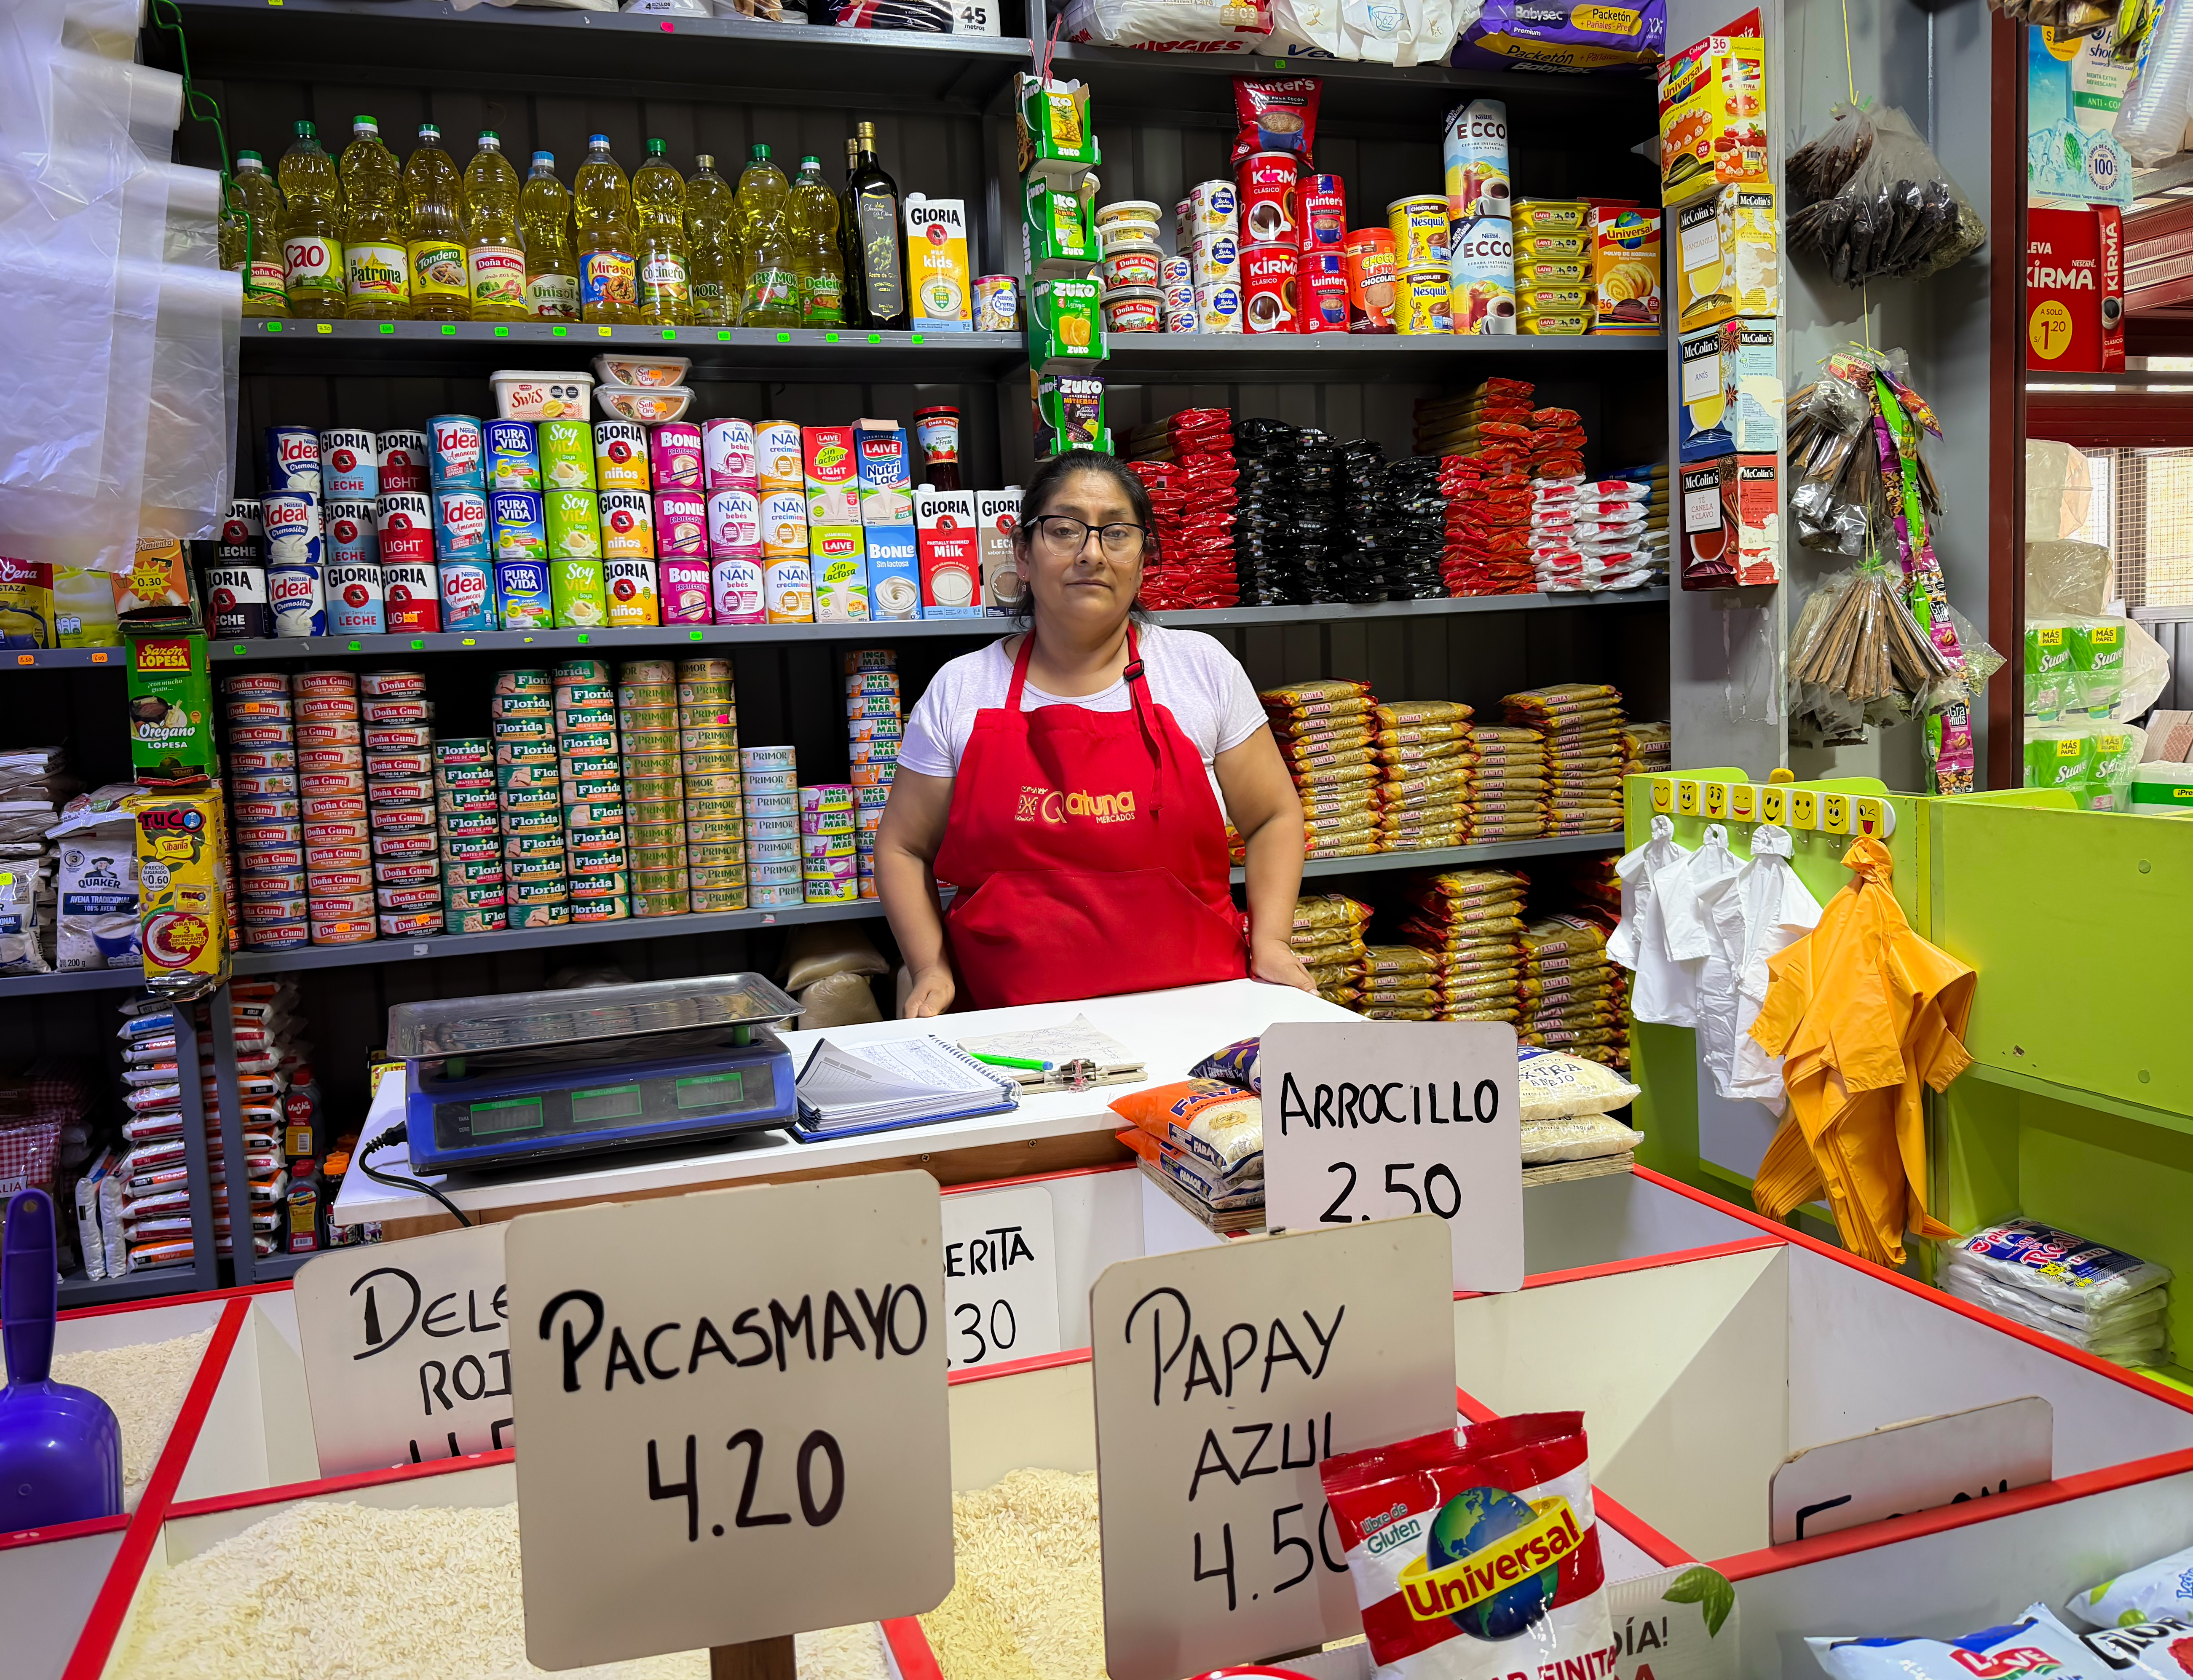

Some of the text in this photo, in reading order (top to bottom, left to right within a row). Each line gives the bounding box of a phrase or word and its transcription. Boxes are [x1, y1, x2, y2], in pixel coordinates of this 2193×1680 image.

[1516, 6, 1563, 21] Babysec
[1593, 8, 1631, 22] Packetón
[1713, 38, 1726, 49] 36
[2088, 98, 2102, 106] ANTI
[1457, 122, 1506, 139] ECCO
[1058, 147, 1080, 157] ZUKO
[2094, 158, 2113, 175] 100
[1253, 185, 1280, 194] CLÁSICO
[1740, 195, 1771, 206] McColin's
[911, 208, 961, 227] GLORIA
[1535, 212, 1551, 220] LAIVE
[1411, 217, 1445, 228] Nesquik
[1607, 223, 1653, 239] Universal
[1684, 234, 1718, 252] MANZANILLA
[1464, 243, 1512, 258] ECCO
[419, 251, 458, 270] Tondero
[478, 259, 501, 269] Doña
[924, 255, 953, 268] kids
[1362, 253, 1394, 268] CHOCO
[351, 265, 401, 283] Patrona
[591, 261, 634, 277] Mirasol
[1251, 277, 1277, 286] CLÁSICO
[533, 284, 575, 300] Unisol
[1053, 282, 1095, 297] ZUKO
[1414, 286, 1447, 297] Nesquik
[1741, 334, 1772, 343] McColin's
[1695, 371, 1708, 381] ANÍS
[1061, 379, 1103, 394] ZUKO
[495, 428, 523, 440] PURA
[550, 423, 578, 446] Soy
[321, 433, 370, 454] GLORIA
[436, 430, 480, 452] Ideal
[502, 438, 528, 450] VIDA
[822, 448, 835, 457] Sin
[866, 443, 898, 453] LAIVE
[814, 453, 846, 465] Lactosa
[605, 467, 638, 479] niños
[867, 460, 901, 479] Nutri
[1743, 468, 1773, 479] McColin's
[383, 476, 418, 488] LIGHT
[873, 473, 897, 486] Lac
[329, 481, 364, 491] LECHE
[1698, 495, 1705, 503] TÉ
[718, 501, 752, 512] NAN
[921, 500, 970, 517] GLORIA
[1691, 504, 1714, 513] CANELA
[265, 504, 308, 528] Ideal
[1695, 511, 1714, 520] CLAVO
[271, 525, 306, 537] Cremosita
[825, 541, 853, 551] LAIVE
[934, 545, 964, 557] Milk
[2, 564, 37, 581] Cena
[138, 578, 161, 587] 0.30
[339, 614, 377, 626] LECHE
[2043, 629, 2060, 639] MÁS
[2096, 628, 2114, 638] MÁS
[142, 644, 183, 656] Sazón
[139, 656, 187, 667] LOPESA
[230, 679, 280, 690] Doña Gumi
[304, 677, 352, 688] Doña Gumi
[503, 698, 550, 709] Florida
[1547, 695, 1568, 704] ANITA
[1949, 705, 1965, 716] Gra
[568, 714, 613, 723] Florida
[437, 744, 486, 755] Florida
[753, 752, 787, 760] PRIMOR
[757, 797, 791, 806] PRIMOR
[825, 795, 847, 803] MAR
[1096, 813, 1135, 824] MERCADOS
[78, 878, 121, 888] QUAKER
[148, 875, 169, 885] 0.60
[809, 880, 830, 888] INCA
[809, 888, 831, 896] MAR
[70, 896, 130, 904] AVENA TRADICIONAL
[1280, 1072, 1500, 1137] ARROCILLO
[539, 1283, 928, 1393] PACASMAYO
[1125, 1287, 1346, 1406] PAPAY
[647, 1428, 846, 1542] 4.20
[1361, 1502, 1408, 1536] Libre de
[1367, 1517, 1422, 1556] Gluten
[1404, 1509, 1580, 1618] Universal
